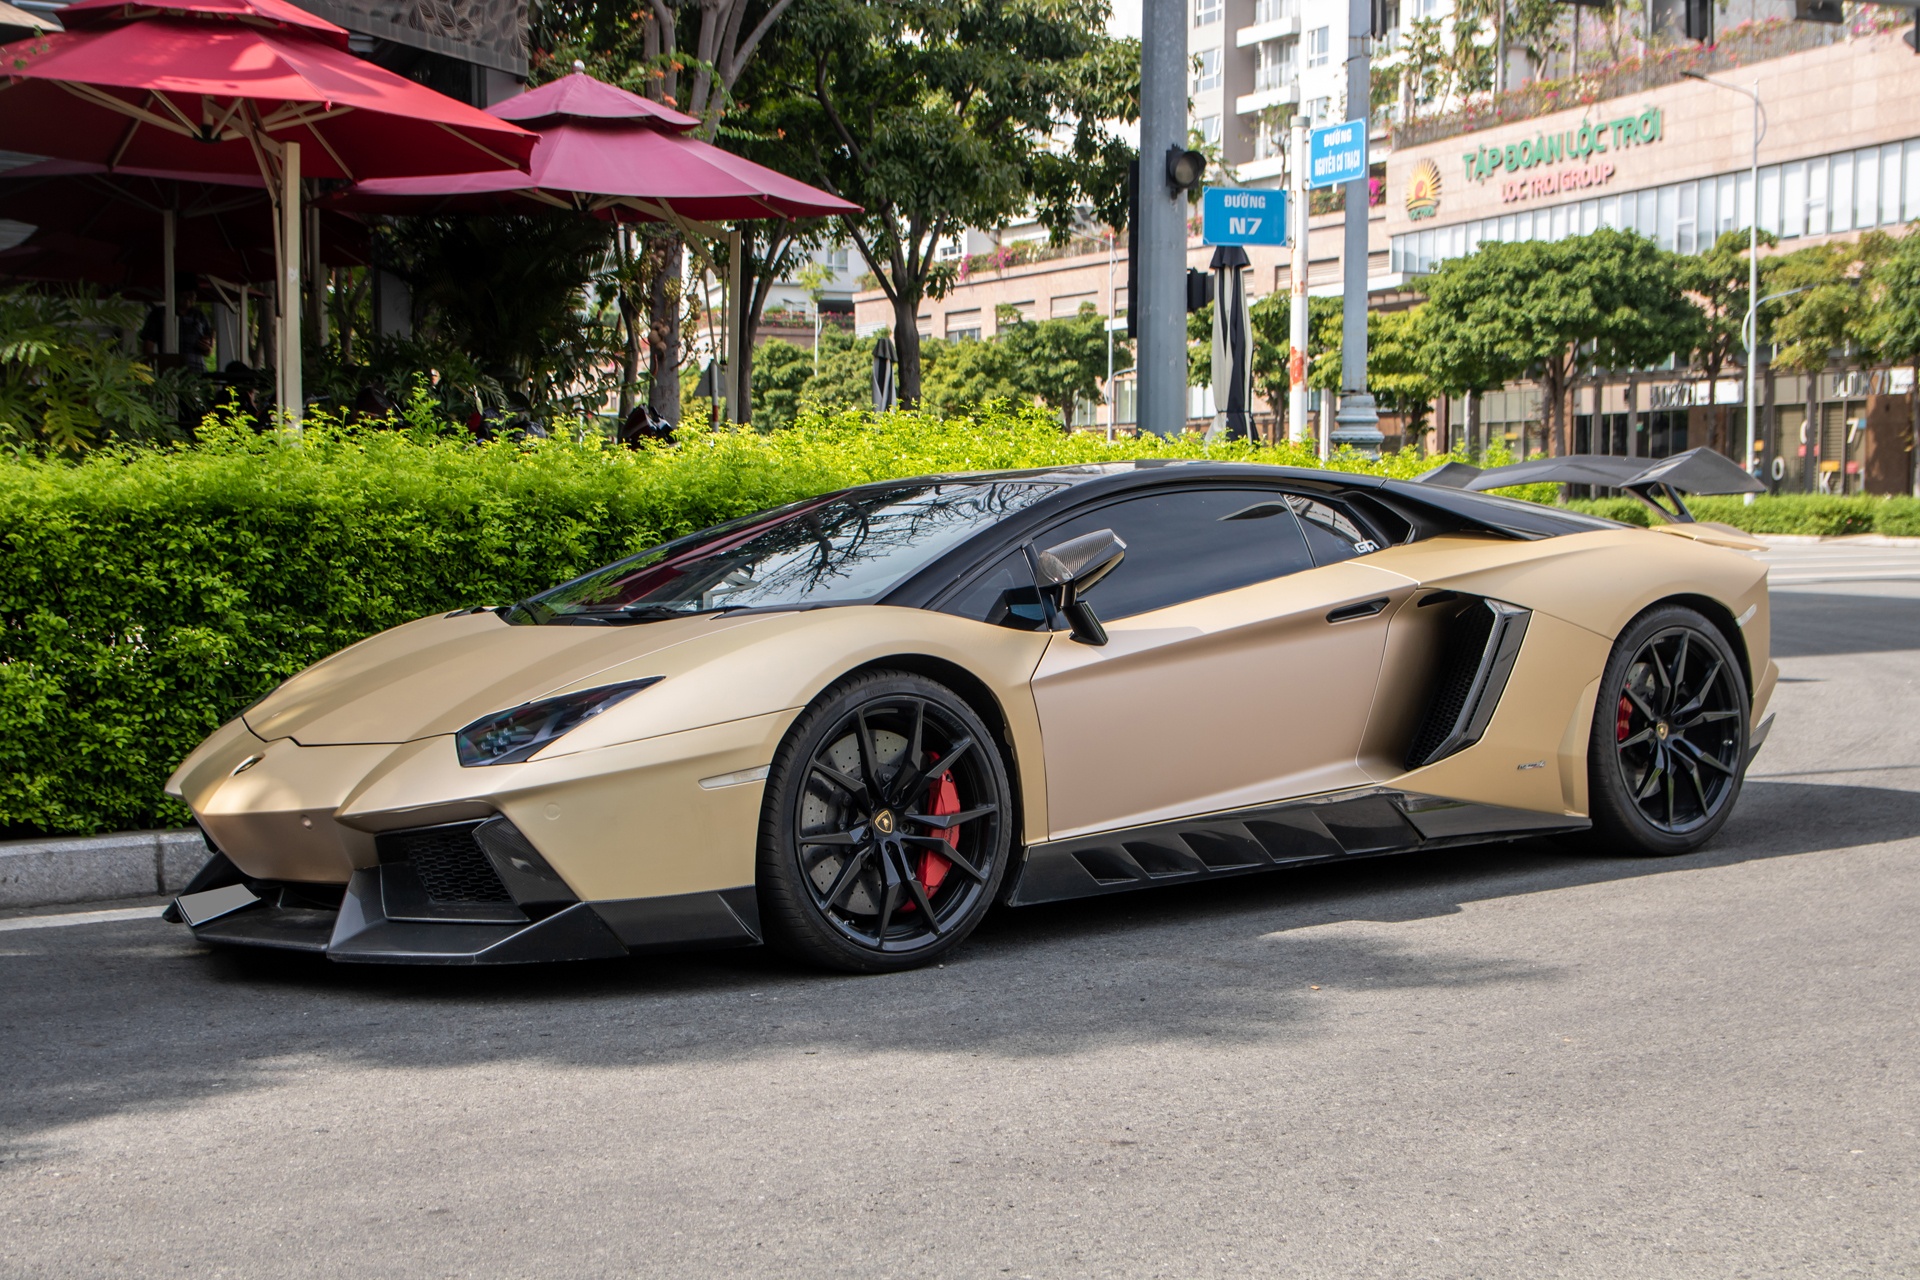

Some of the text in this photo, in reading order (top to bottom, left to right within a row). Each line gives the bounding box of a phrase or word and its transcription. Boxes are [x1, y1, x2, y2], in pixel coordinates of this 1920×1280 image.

[1323, 128, 1352, 148] ĐƯỜNG
[1503, 131, 1562, 173] ĐOÀN
[1561, 162, 1615, 193] GROUP
[1224, 192, 1266, 209] ĐƯỜNG
[1229, 217, 1262, 235] N7
